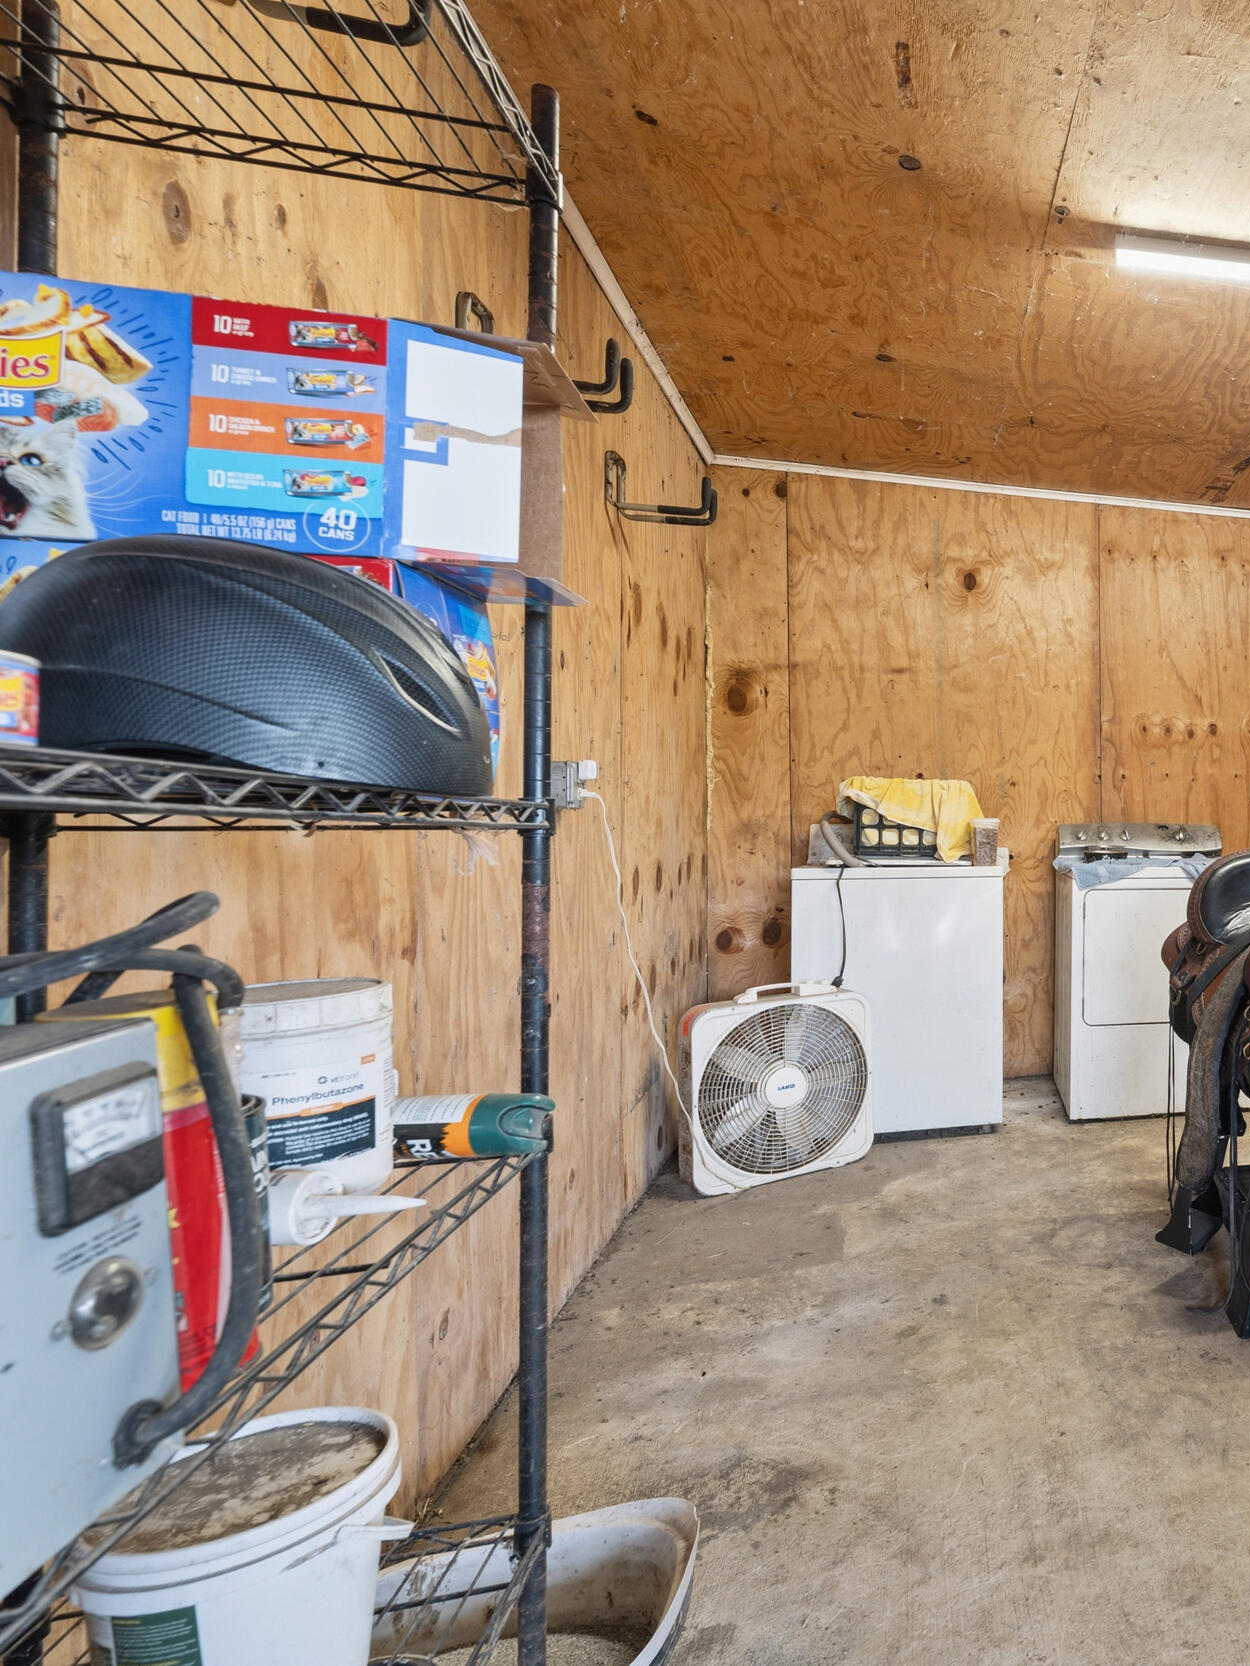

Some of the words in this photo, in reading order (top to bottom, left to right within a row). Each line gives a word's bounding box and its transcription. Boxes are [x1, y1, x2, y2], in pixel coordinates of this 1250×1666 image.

[213, 314, 232, 335] 10
[211, 364, 230, 384] 10
[208, 414, 227, 433] 10
[207, 469, 226, 488] 10
[275, 518, 297, 530] CANS
[319, 506, 358, 531] 40
[317, 526, 356, 541] CANS
[271, 1083, 365, 1106] Phenylbutazone
